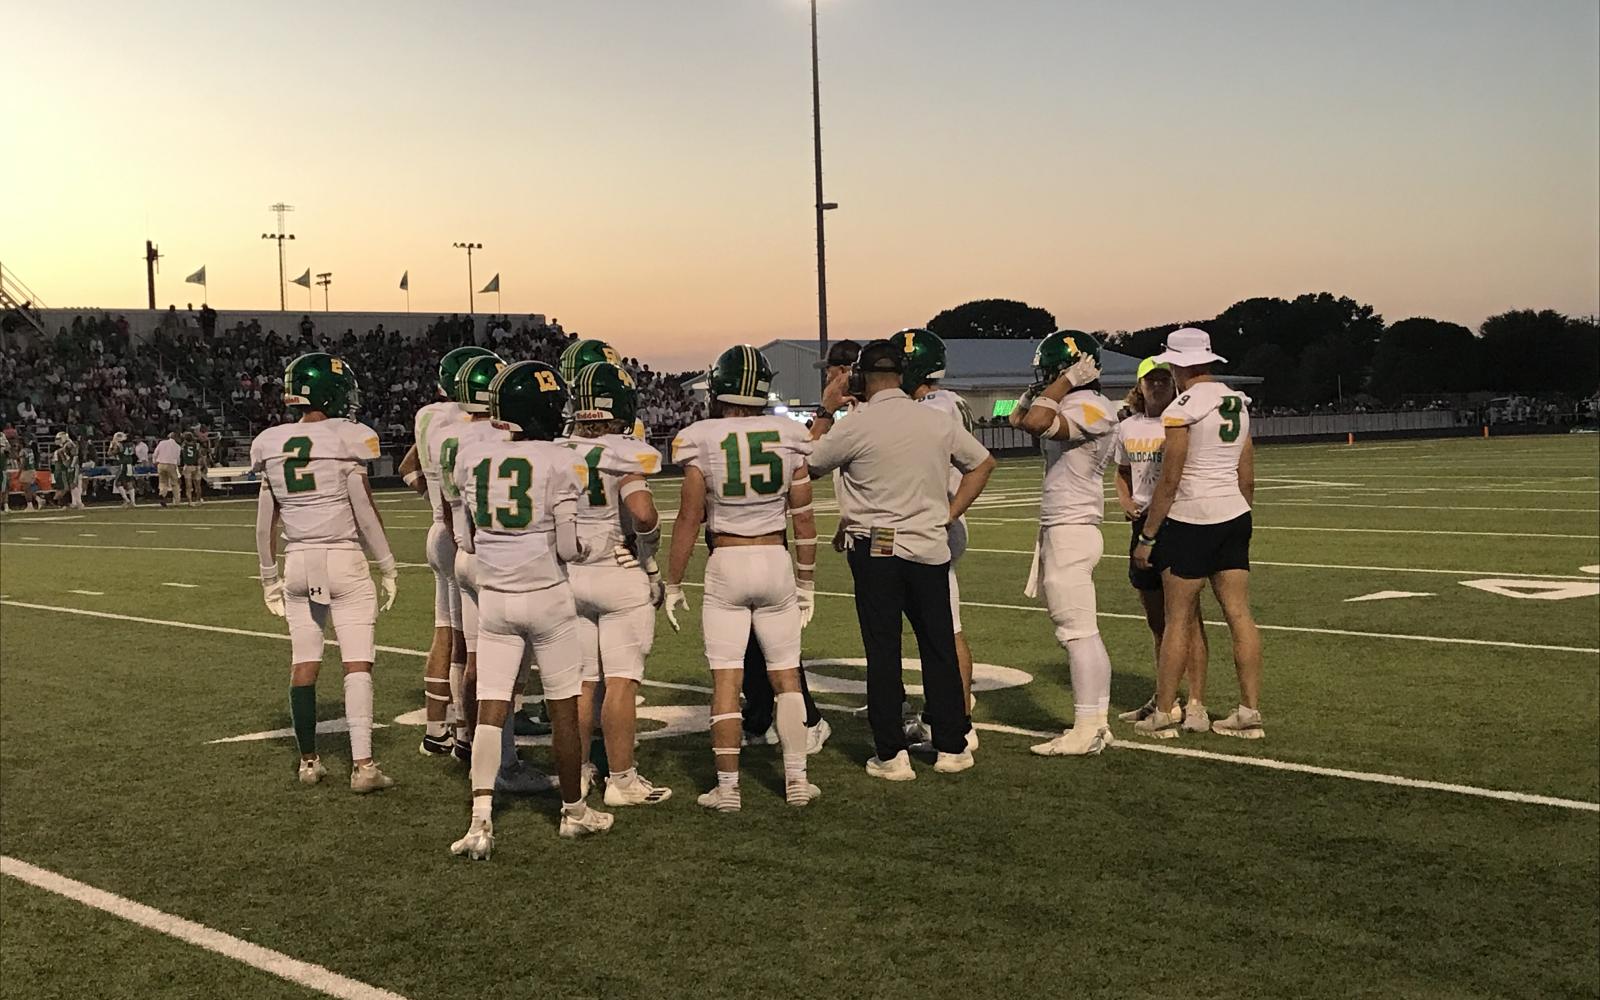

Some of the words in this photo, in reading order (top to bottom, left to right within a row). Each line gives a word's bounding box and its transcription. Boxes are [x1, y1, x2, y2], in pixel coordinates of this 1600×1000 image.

[330, 358, 344, 375] 2
[534, 370, 560, 392] 13
[1178, 395, 1191, 406] 9
[1218, 396, 1242, 443] 9
[282, 436, 317, 493] 2
[720, 431, 784, 497] 15
[472, 457, 533, 529] 13
